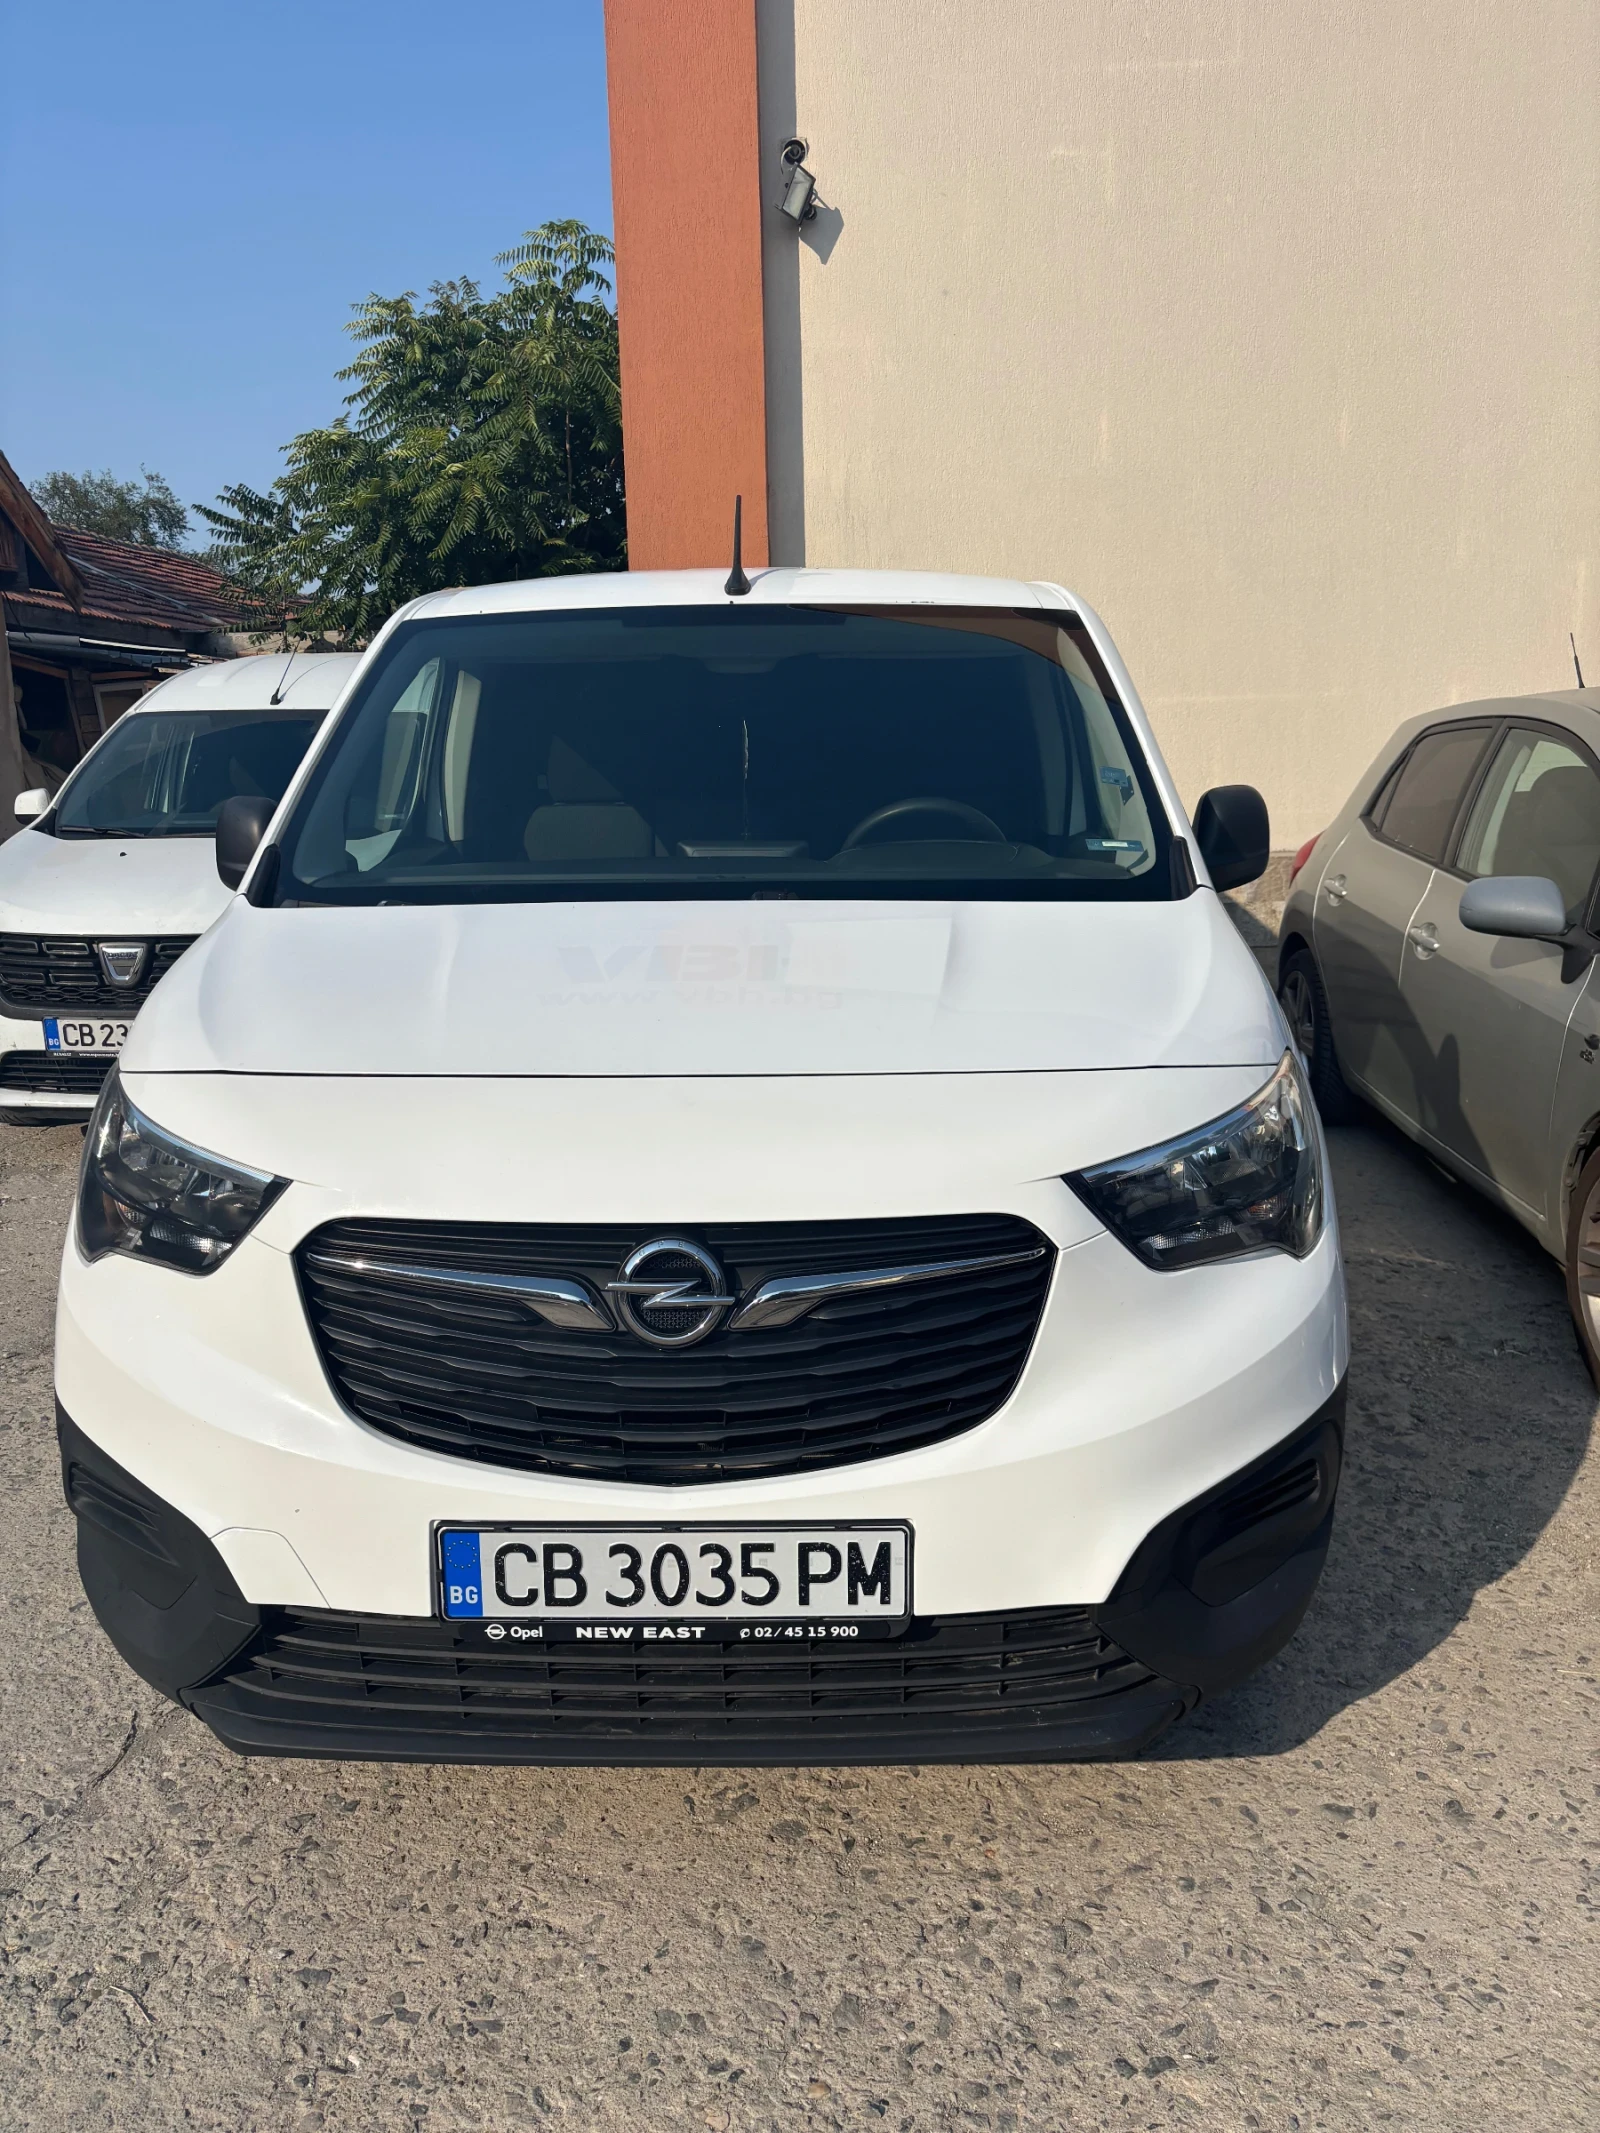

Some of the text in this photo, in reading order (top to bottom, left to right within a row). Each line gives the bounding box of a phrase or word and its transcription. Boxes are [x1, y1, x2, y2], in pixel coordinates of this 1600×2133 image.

[48, 1037, 60, 1046] BG
[63, 1023, 95, 1046] CB
[637, 1239, 703, 1258] OPEL
[494, 1541, 892, 1608] CB 3035 PM
[450, 1585, 479, 1604] BG
[510, 1625, 543, 1641] Opel
[575, 1626, 634, 1639] NEW
[643, 1626, 706, 1639] EAST
[830, 1625, 859, 1637] 900
